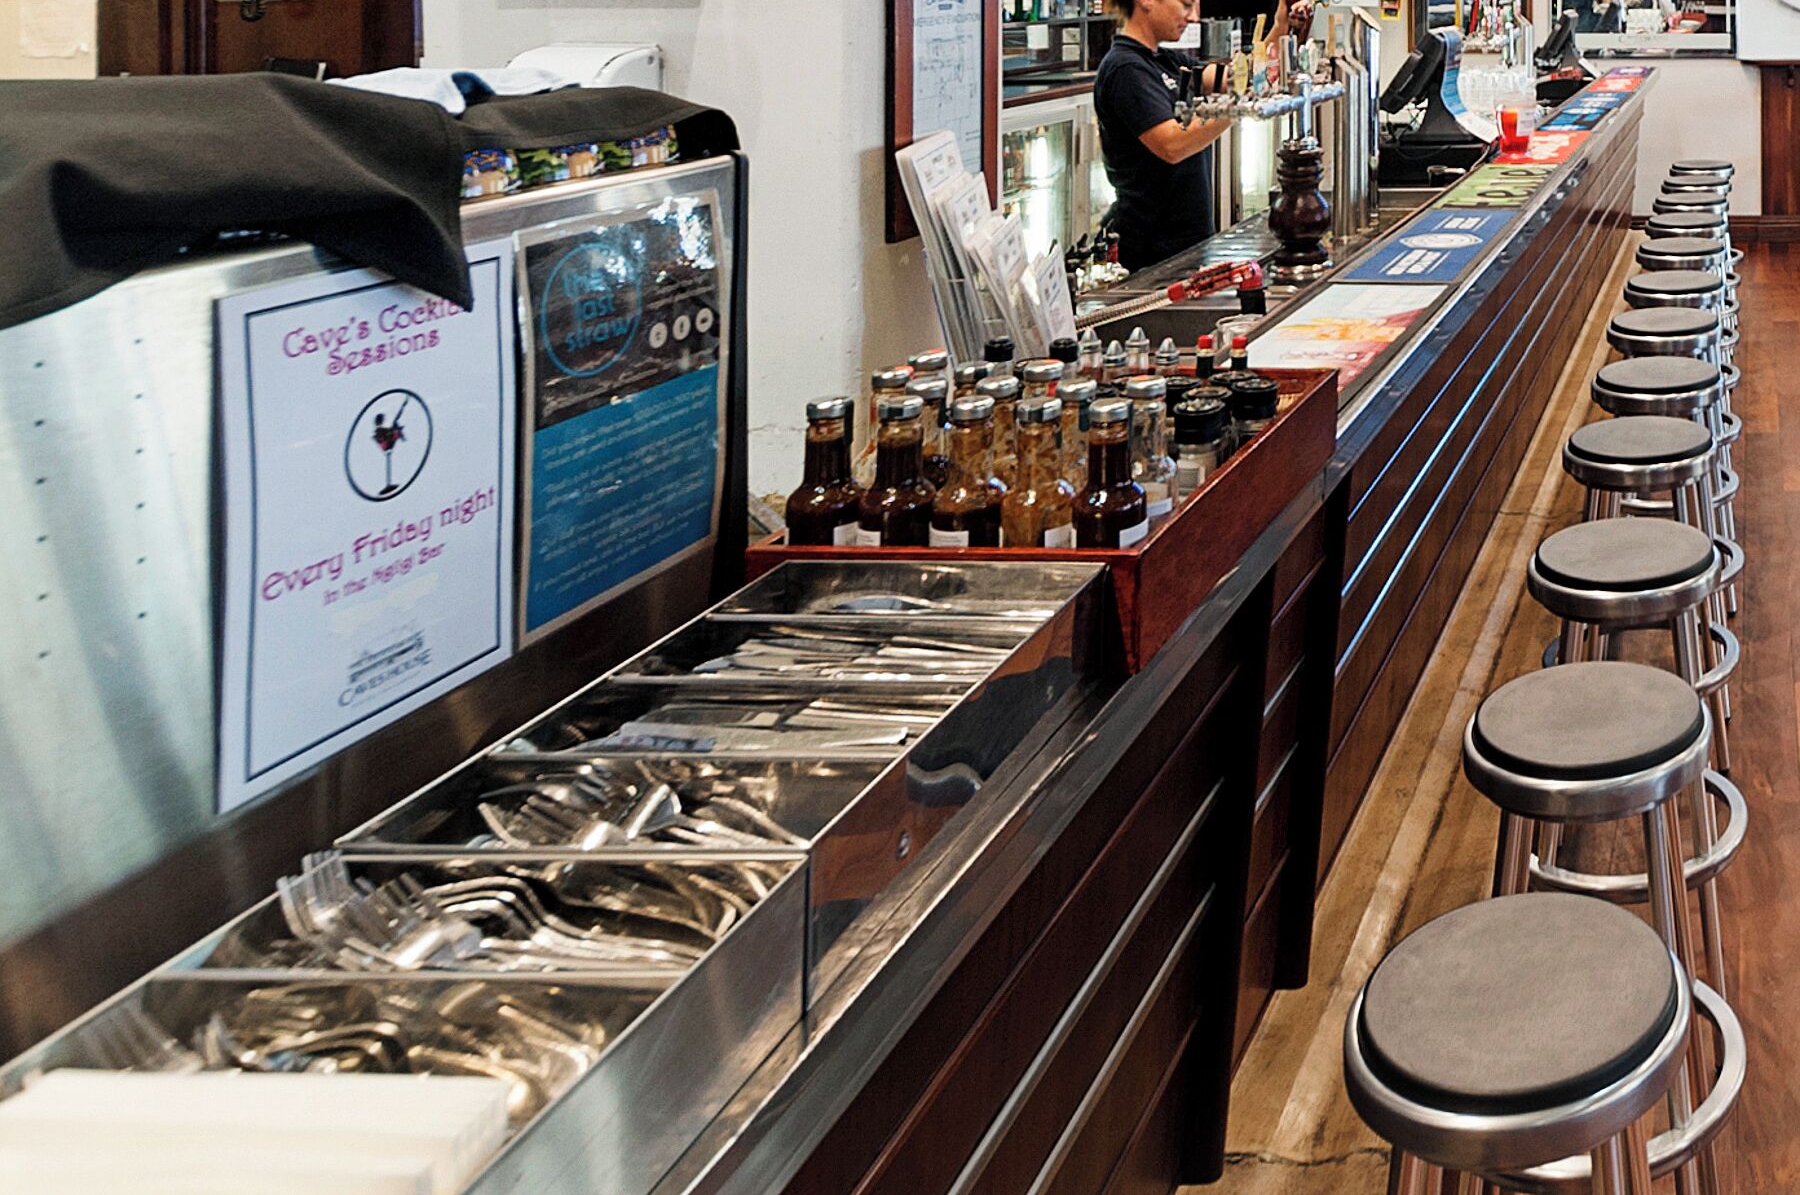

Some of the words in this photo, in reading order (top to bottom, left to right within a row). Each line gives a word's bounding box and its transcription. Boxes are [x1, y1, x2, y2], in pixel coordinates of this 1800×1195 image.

[283, 316, 370, 358] Cave's
[326, 327, 440, 376] Sessions
[352, 515, 433, 565] Friday
[439, 486, 496, 527] night
